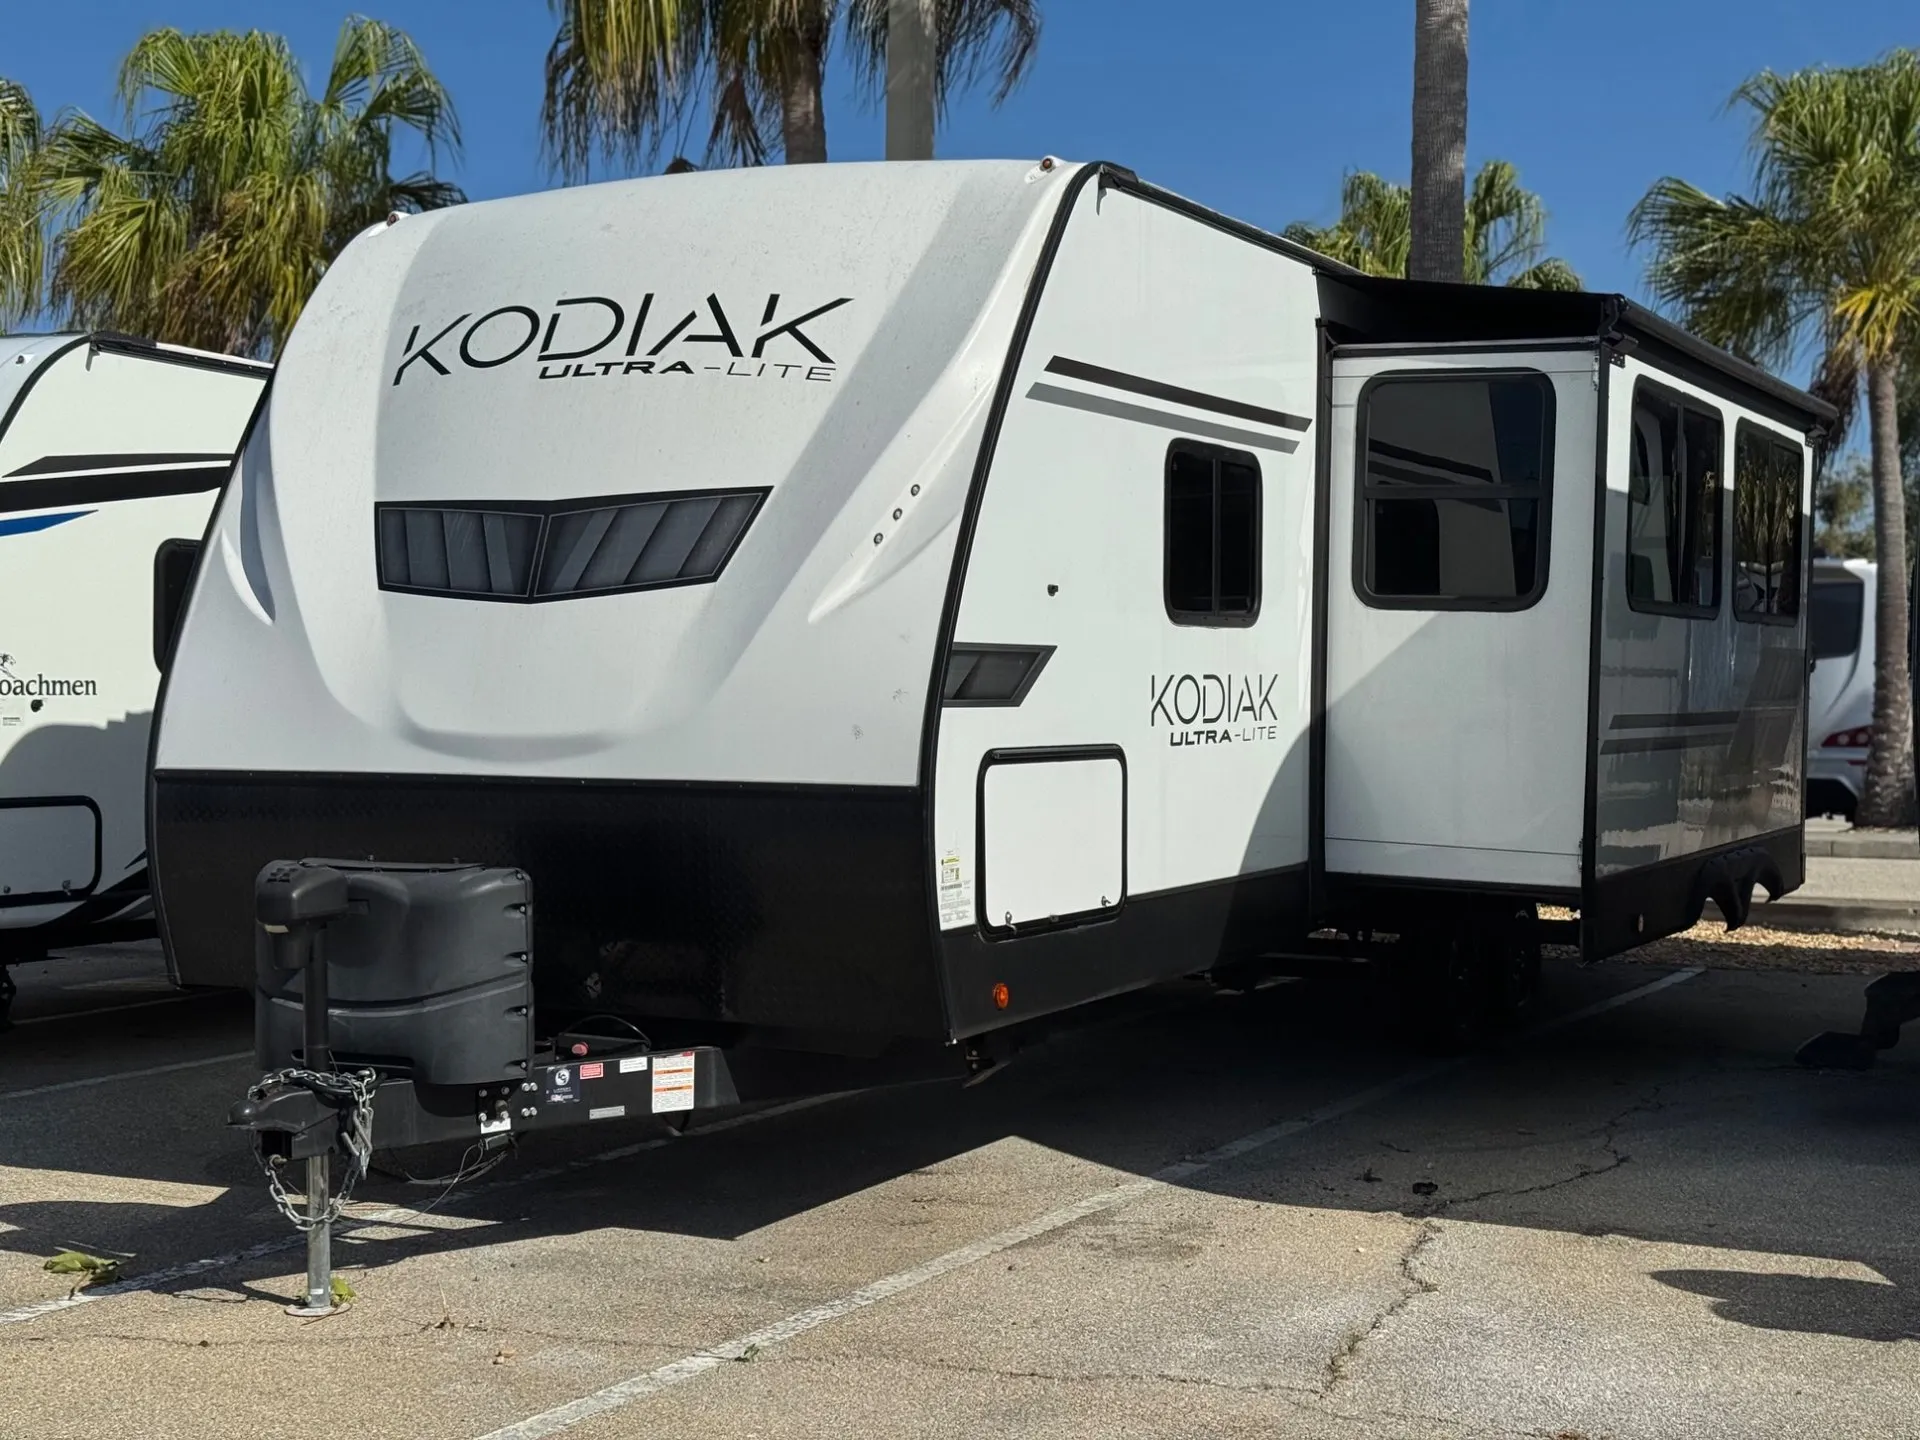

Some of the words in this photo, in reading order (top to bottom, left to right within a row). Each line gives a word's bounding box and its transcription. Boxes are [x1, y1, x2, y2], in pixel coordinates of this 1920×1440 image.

[393, 293, 855, 386] KODIAK
[538, 360, 837, 382] ULTRA-LITE
[0, 673, 98, 696] oachmen
[1151, 674, 1279, 727] KODIAK
[1170, 726, 1278, 747] ULTRA-LITE
